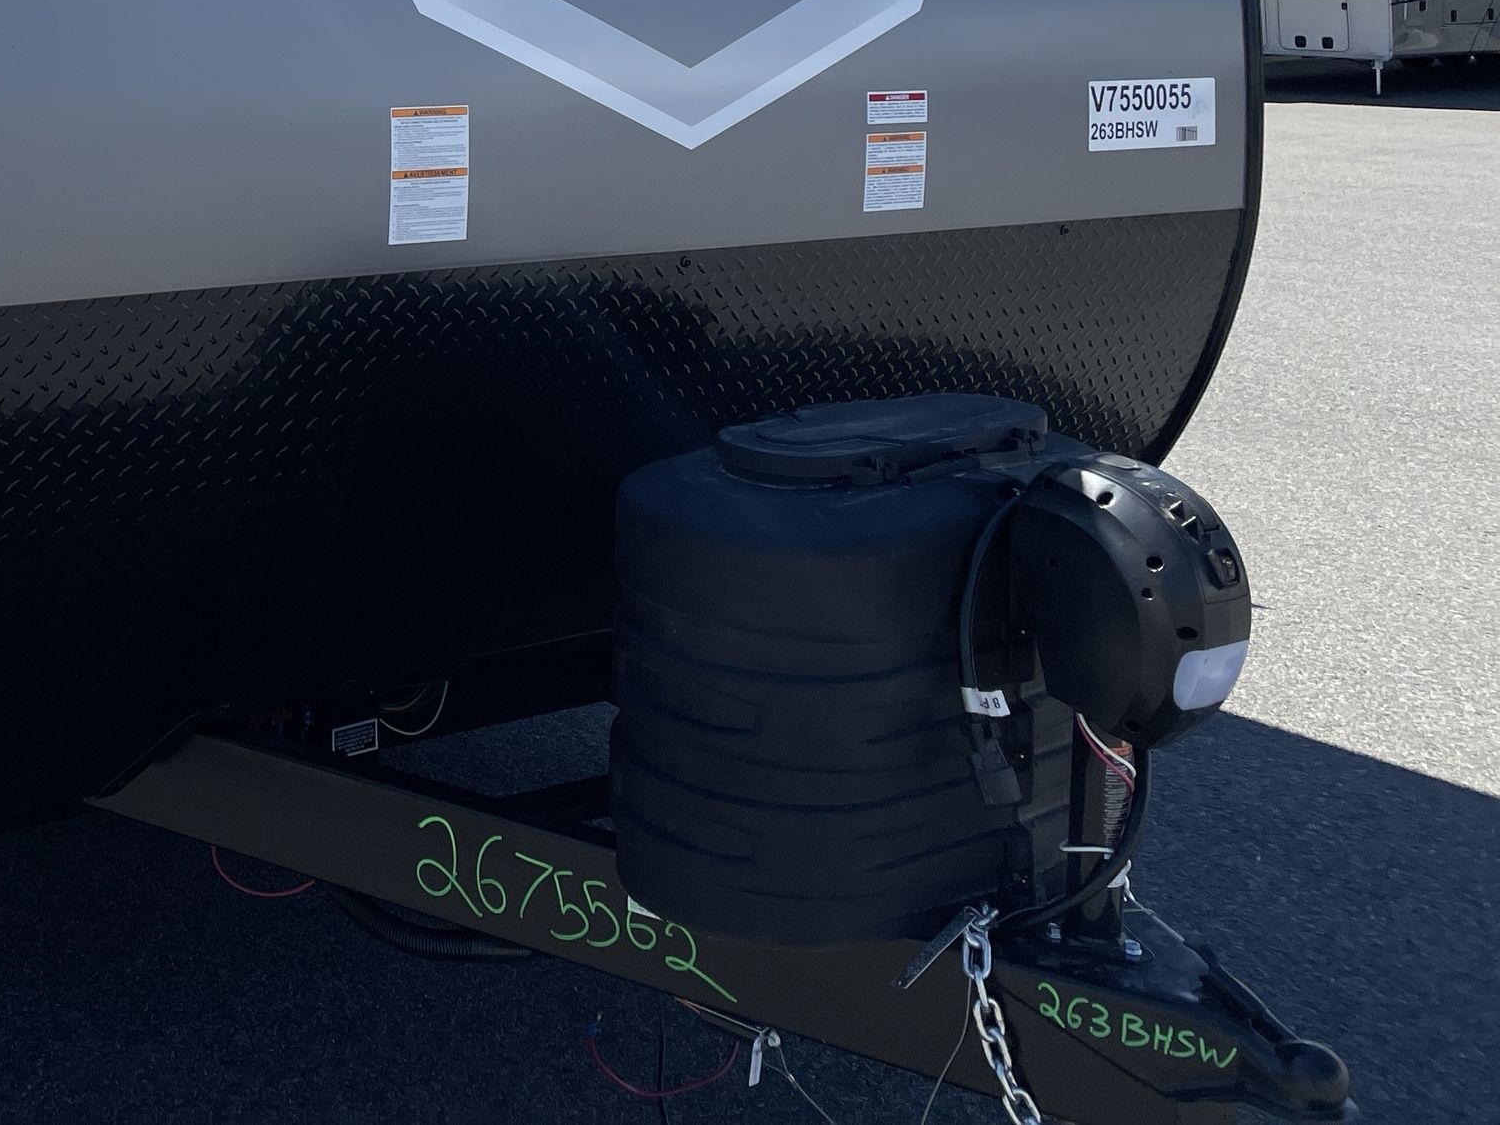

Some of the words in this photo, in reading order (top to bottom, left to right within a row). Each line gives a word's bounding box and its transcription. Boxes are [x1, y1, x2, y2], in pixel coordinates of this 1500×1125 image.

[1091, 83, 1192, 112] V7550055
[1090, 120, 1158, 140] 263BHSW
[416, 816, 738, 1003] 2675562
[1037, 982, 1238, 1069] 263BHSW
